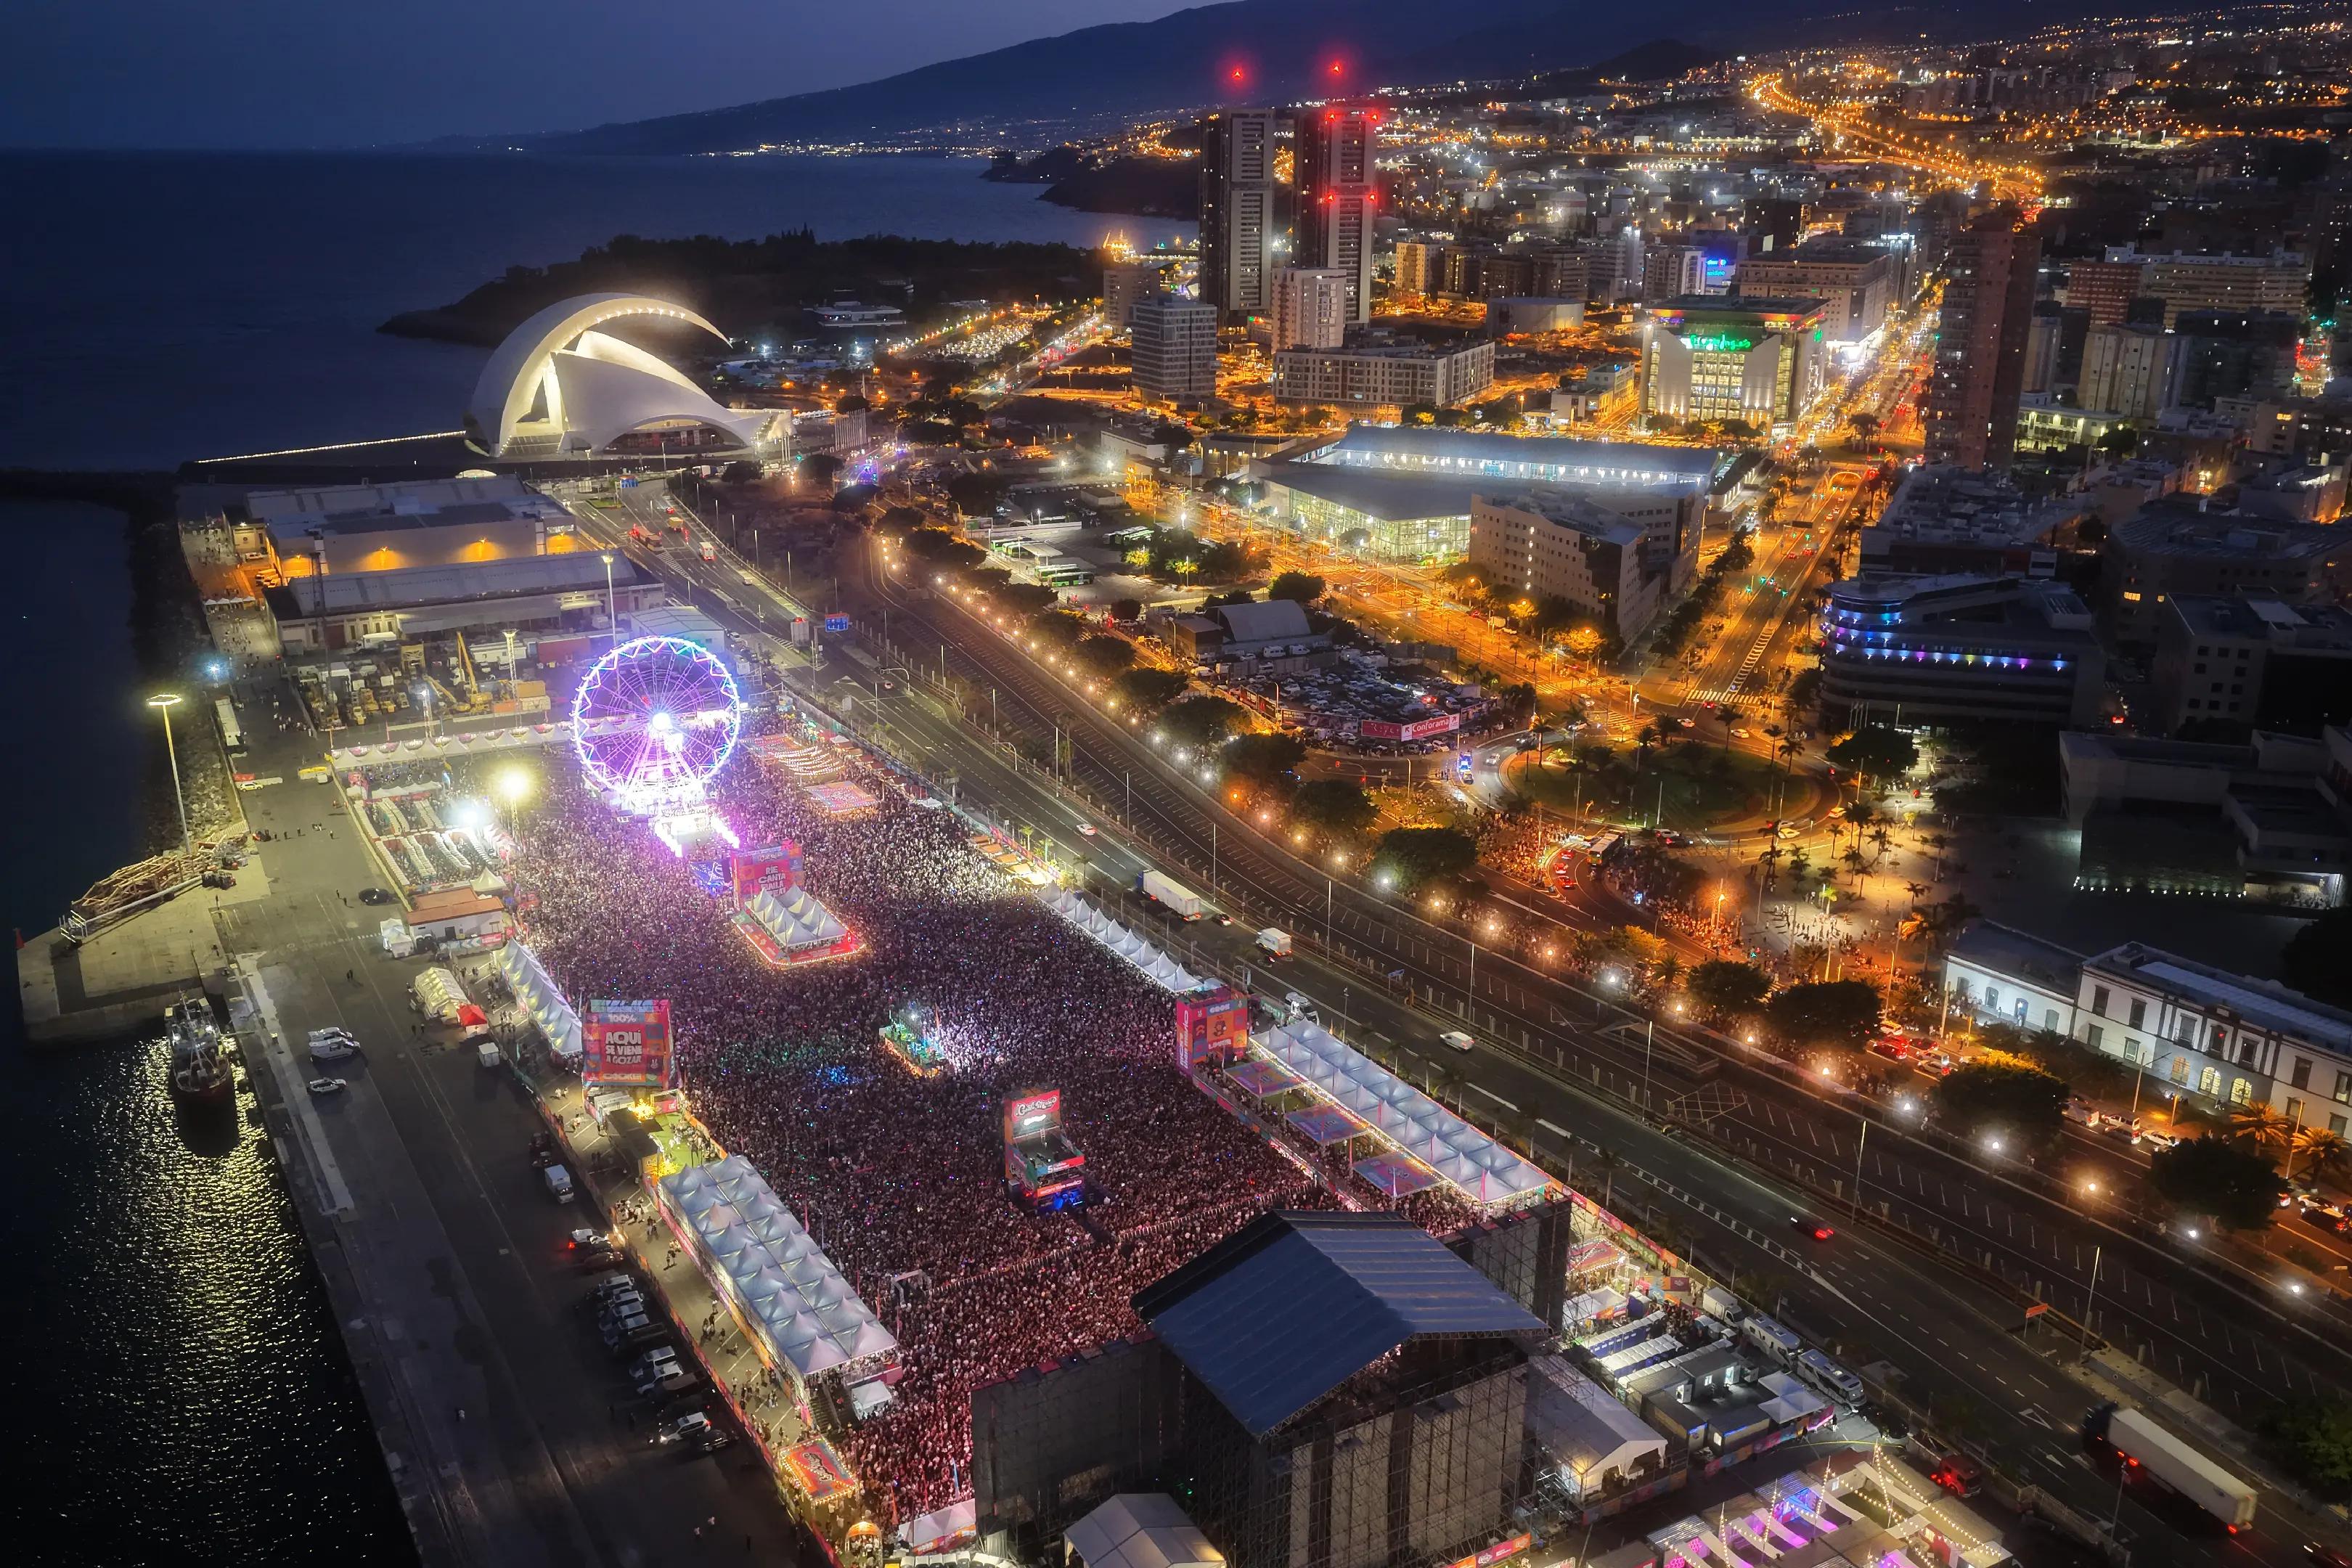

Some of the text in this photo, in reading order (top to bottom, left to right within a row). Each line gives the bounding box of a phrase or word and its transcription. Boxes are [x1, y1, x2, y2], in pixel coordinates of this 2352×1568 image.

[1412, 719, 1449, 732] Conforama
[758, 873, 785, 883] CANTA
[608, 1014, 637, 1023] 100%
[605, 1029, 642, 1045] AQUÍ
[605, 1045, 642, 1055] SE VIENE
[613, 1055, 642, 1064] GOZAR
